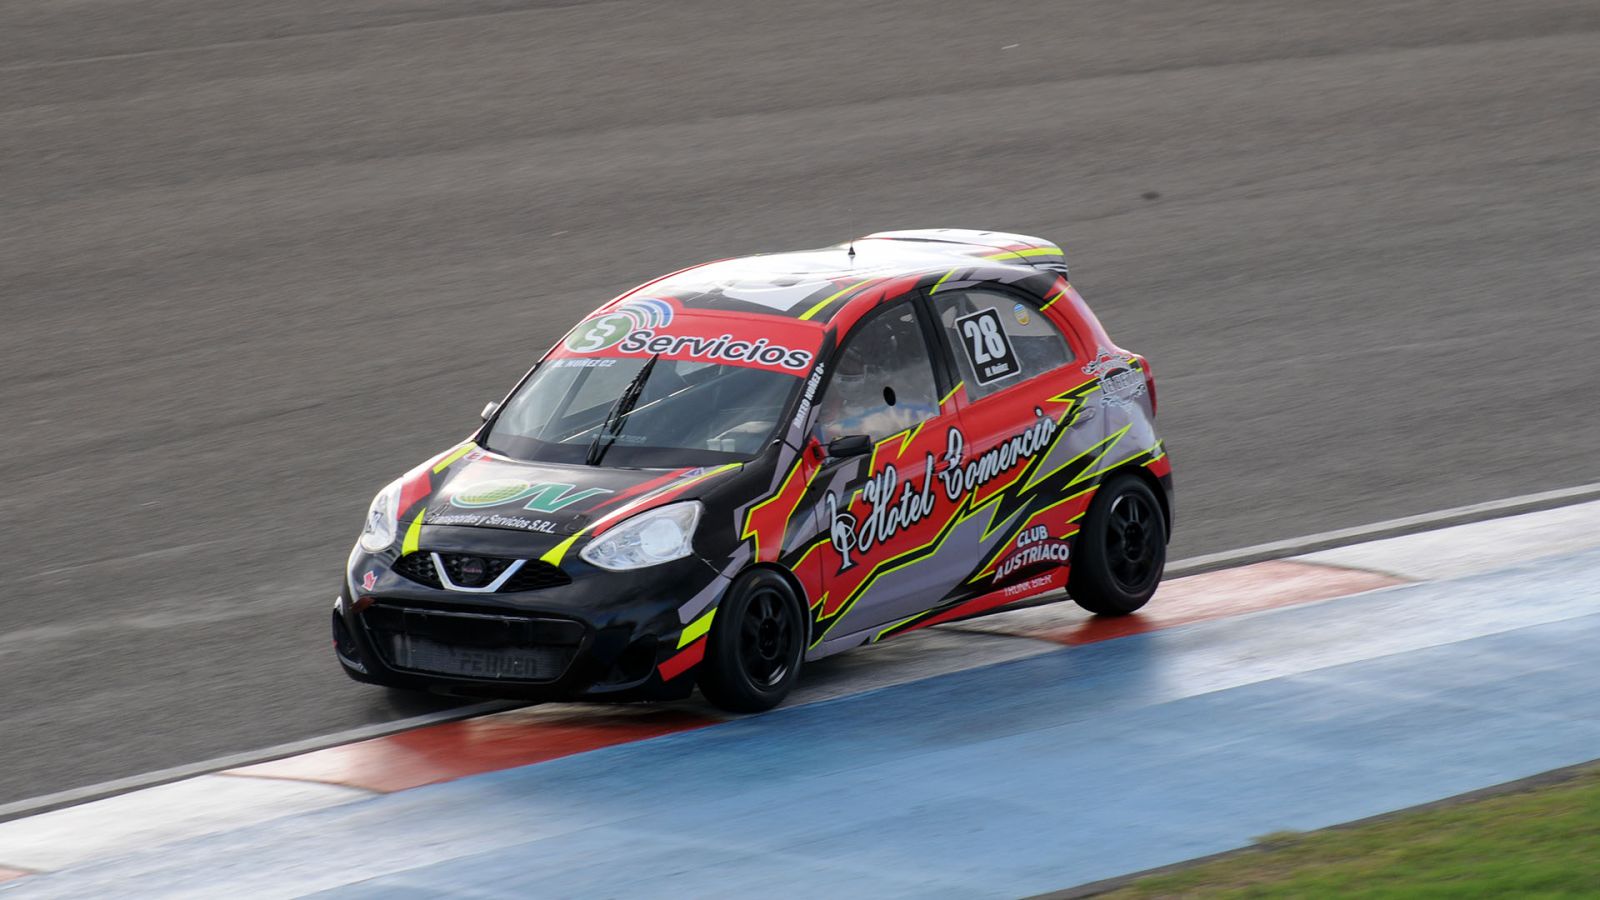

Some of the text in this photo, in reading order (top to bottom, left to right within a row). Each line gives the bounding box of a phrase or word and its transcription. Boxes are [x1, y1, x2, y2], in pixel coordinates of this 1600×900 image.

[619, 329, 812, 369] Servicios
[963, 314, 1007, 365] 28
[793, 398, 811, 429] MATEO
[804, 372, 822, 400] NUÑEZ
[858, 407, 1056, 552] Hotel Comercio
[486, 513, 530, 528] Servicios
[1016, 525, 1049, 548] CLUB
[991, 540, 1070, 585] AUSTRÍACO
